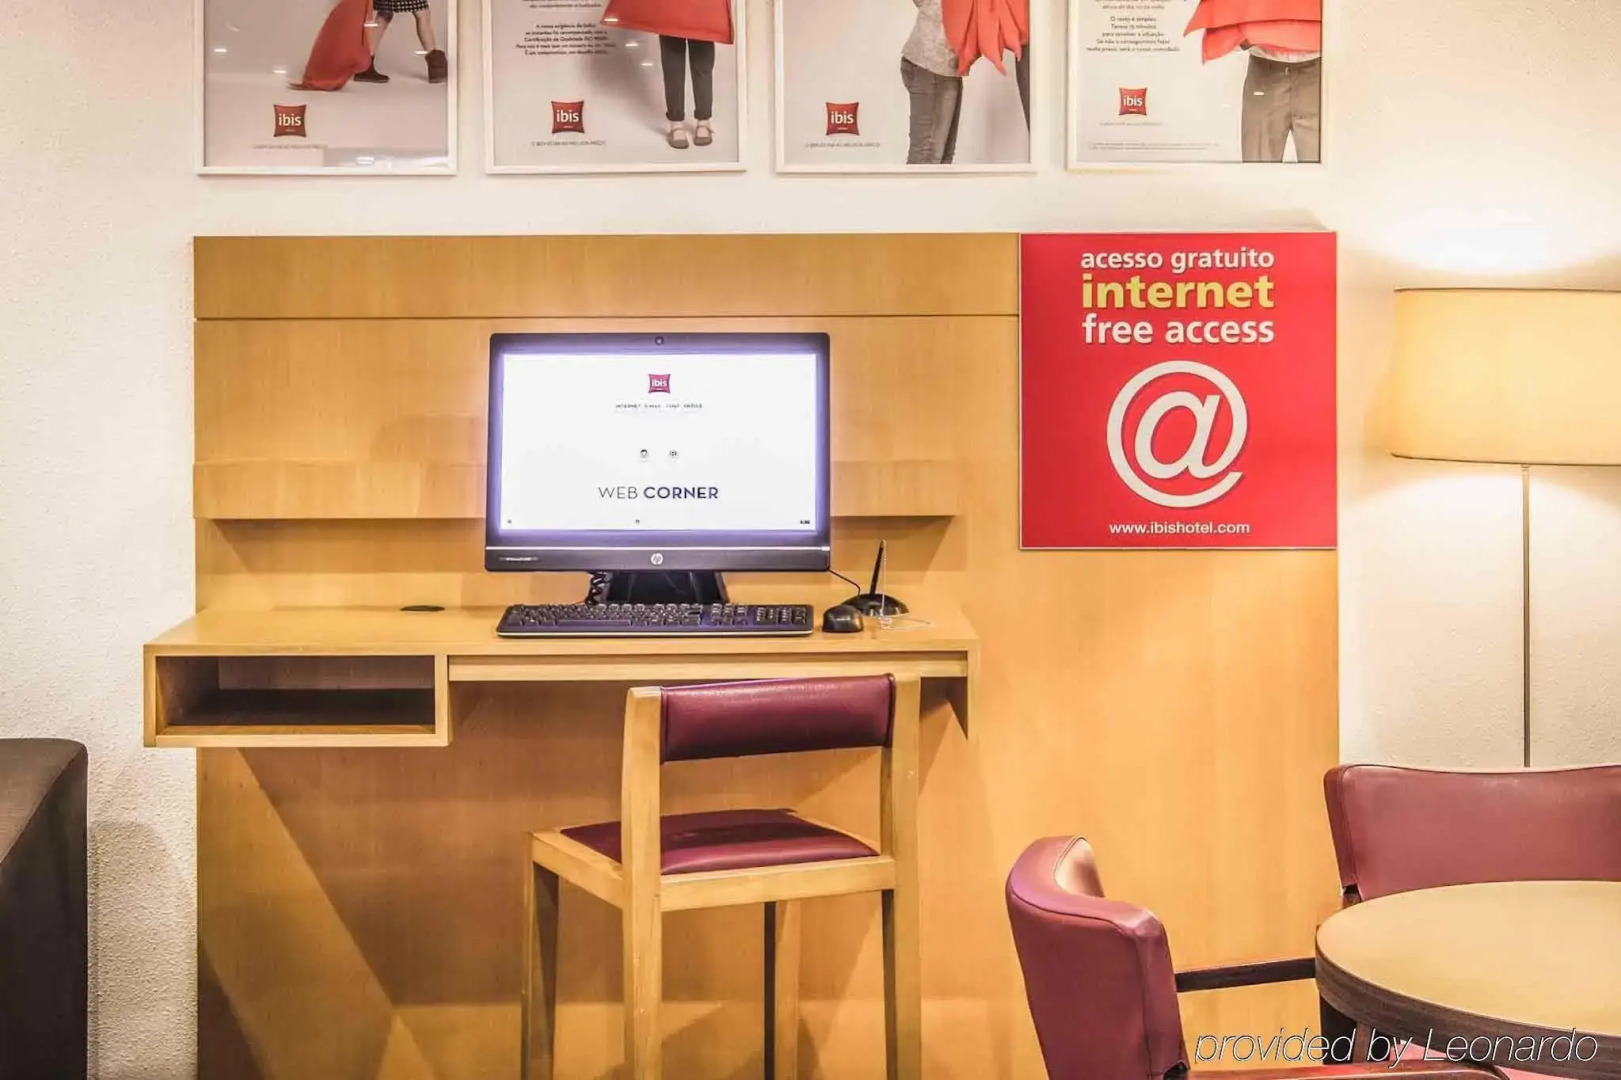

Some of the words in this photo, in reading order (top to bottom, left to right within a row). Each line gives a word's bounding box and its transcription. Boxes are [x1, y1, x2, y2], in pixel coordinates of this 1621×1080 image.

[1123, 95, 1143, 107] ibis
[278, 113, 302, 126] ibis
[556, 110, 579, 122] ibis
[831, 111, 855, 124] ibis
[1081, 250, 1163, 269] acesso
[1171, 247, 1275, 274] gratuito
[1082, 273, 1275, 309] internet
[1082, 313, 1153, 344] free
[1165, 320, 1275, 344] access
[651, 378, 668, 387] ibis
[598, 486, 639, 500] WEB
[643, 486, 719, 499] CORNER
[1109, 521, 1250, 535] www.ibishotel.com
